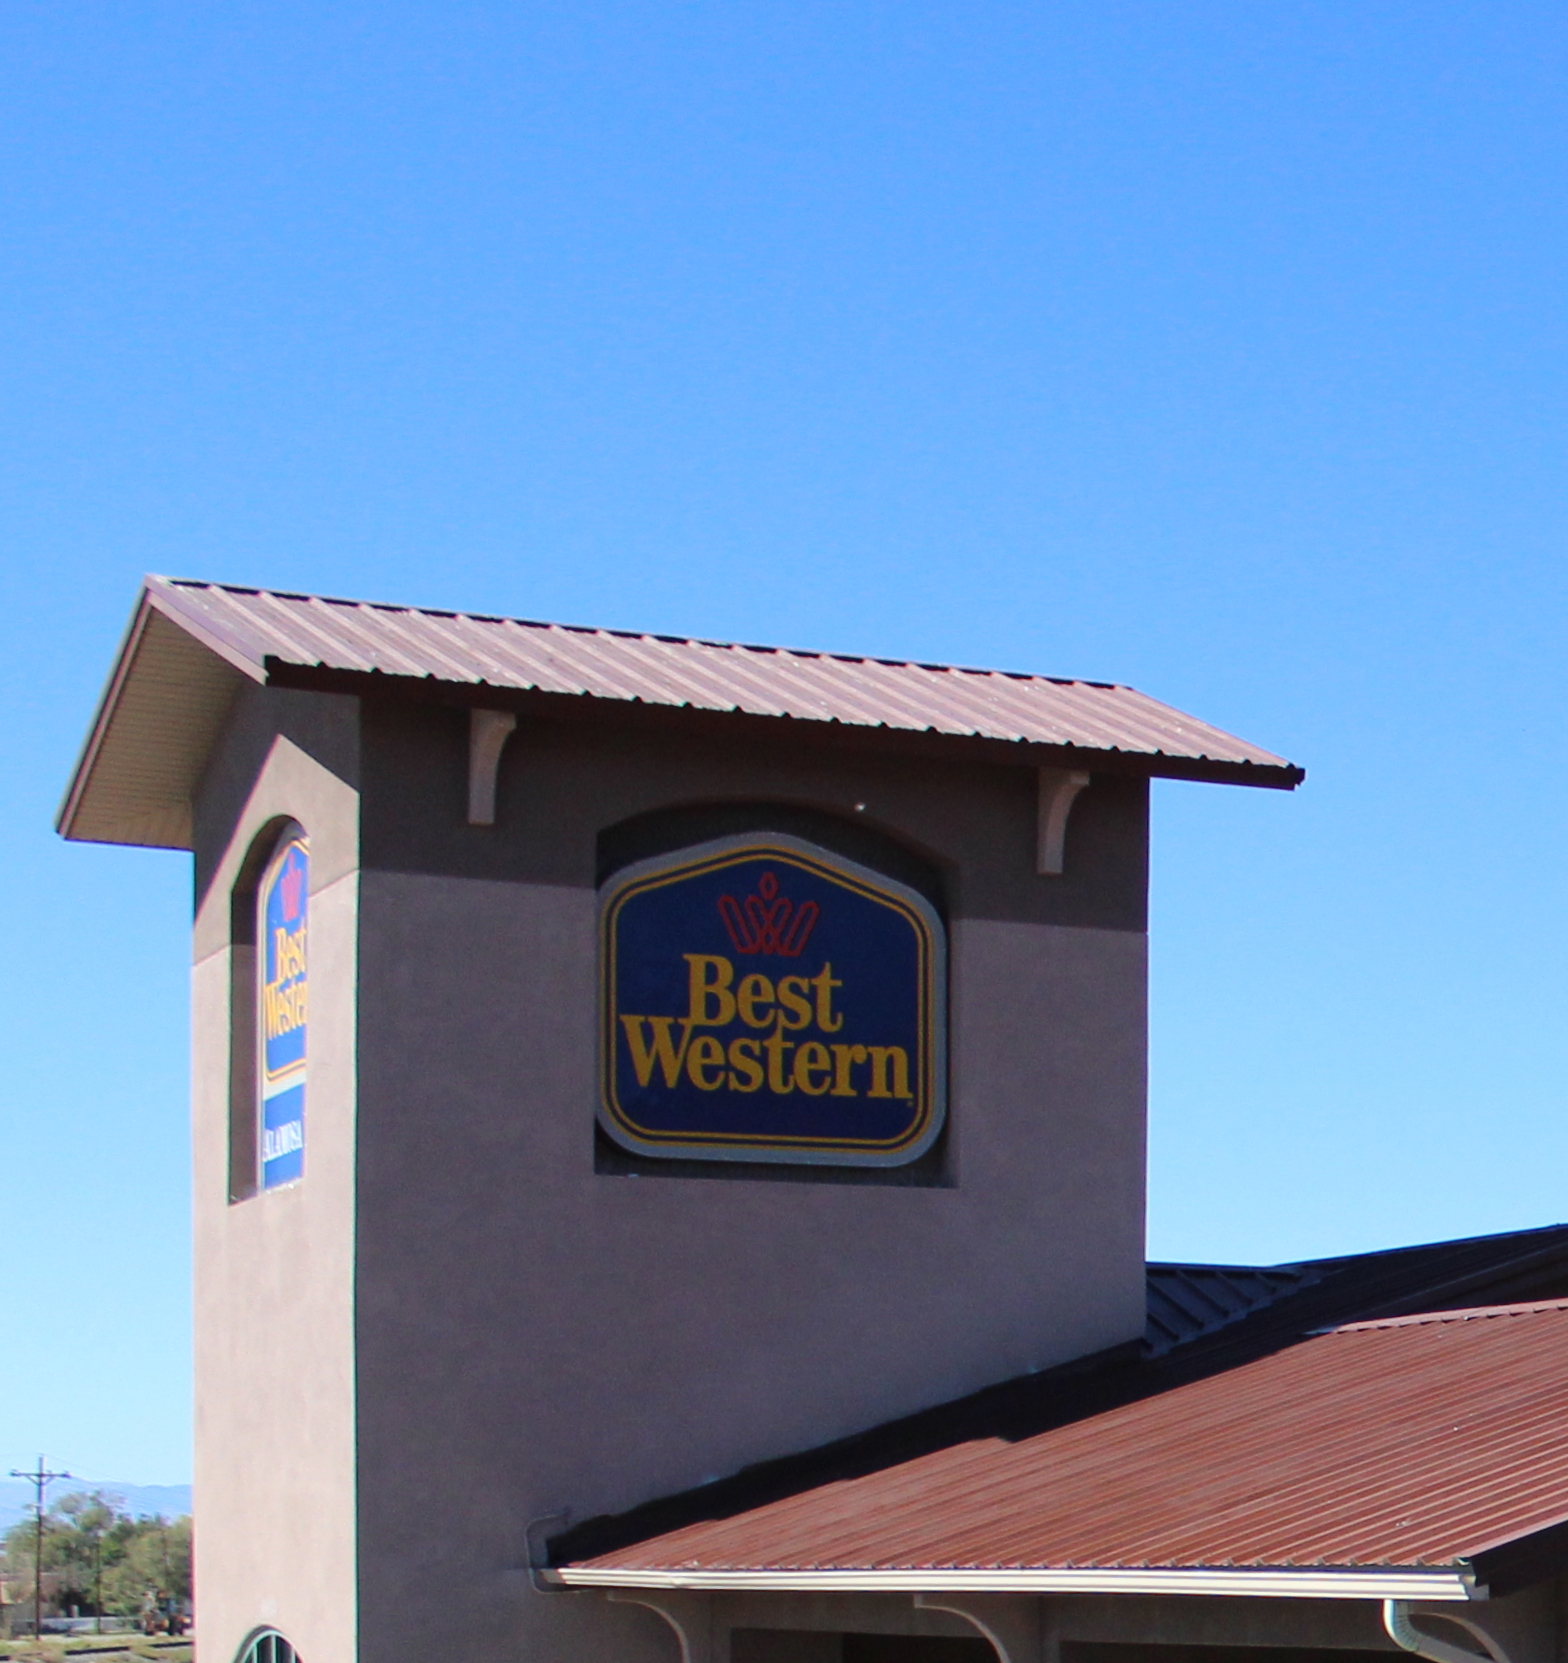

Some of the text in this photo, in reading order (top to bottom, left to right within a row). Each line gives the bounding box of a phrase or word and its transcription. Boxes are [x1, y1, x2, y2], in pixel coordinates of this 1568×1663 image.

[274, 918, 307, 983] Best
[683, 953, 843, 1033] Best
[619, 1008, 912, 1099] Western
